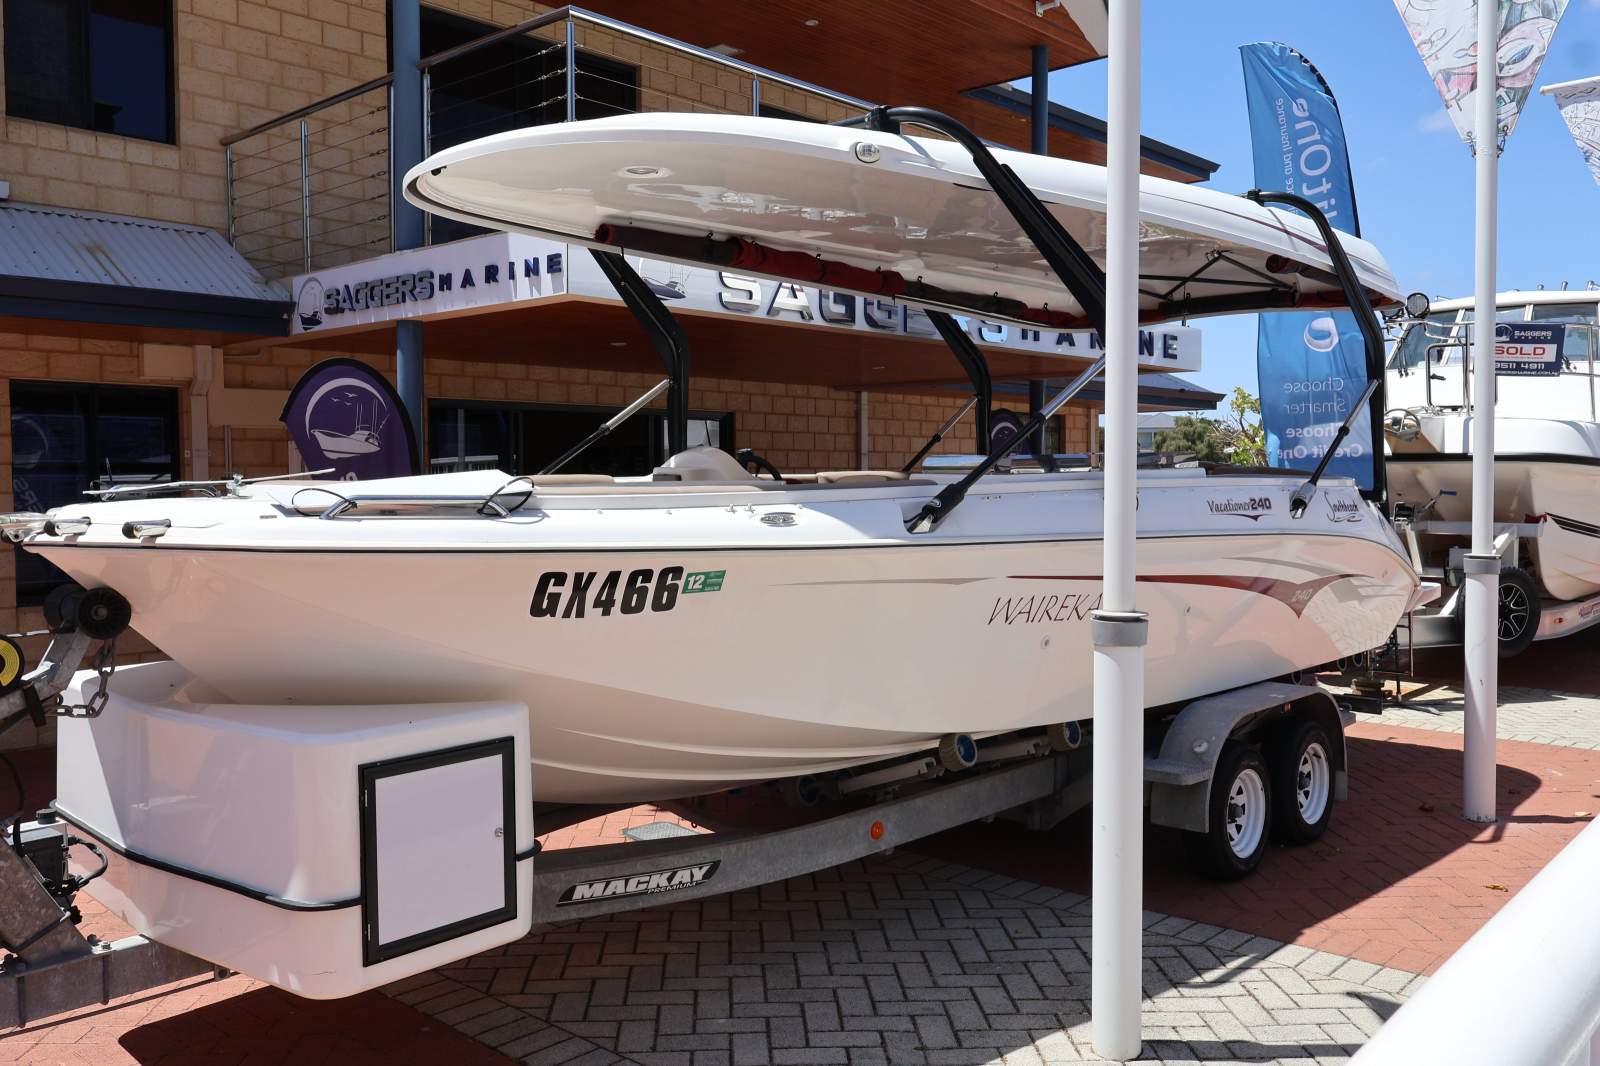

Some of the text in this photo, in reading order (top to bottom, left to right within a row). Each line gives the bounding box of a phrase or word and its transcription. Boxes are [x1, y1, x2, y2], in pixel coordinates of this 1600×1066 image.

[324, 252, 562, 315] SAGGERS MARINE
[718, 271, 1008, 344] SAGGES
[1495, 346, 1546, 356] SOLD
[1521, 362, 1545, 370] 4911
[529, 566, 684, 618] GX466
[687, 575, 705, 590] 12
[988, 593, 1103, 625] WAIREKA
[572, 865, 711, 901] MACKAY
[647, 881, 698, 894] PREMIUM
